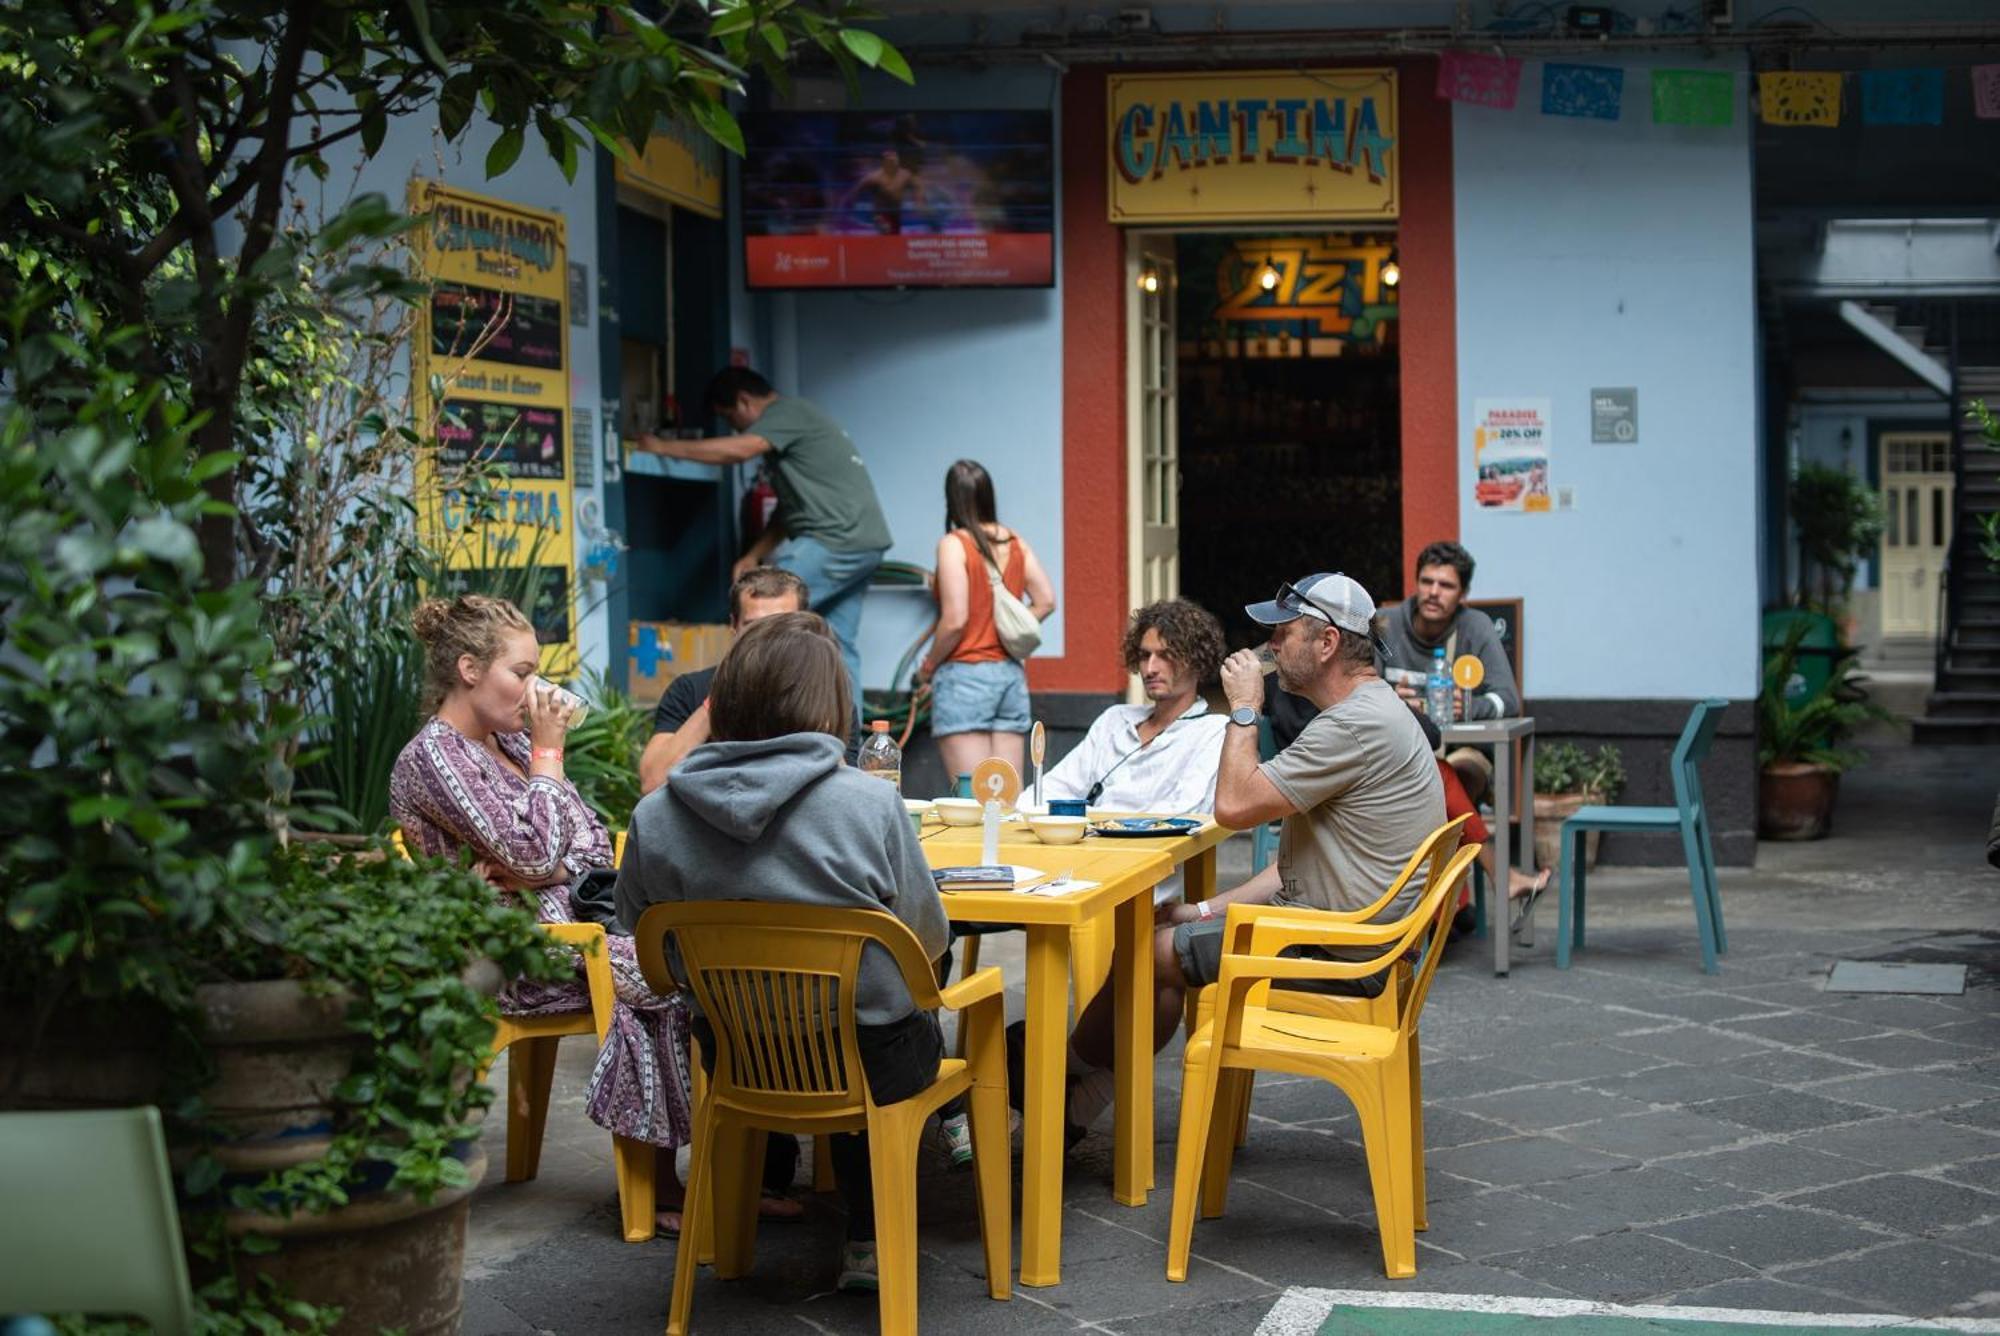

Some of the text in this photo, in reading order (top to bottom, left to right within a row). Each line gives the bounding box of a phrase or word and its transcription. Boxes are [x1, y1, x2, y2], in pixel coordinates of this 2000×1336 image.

[1114, 97, 1395, 184] CANTINA
[1488, 410, 1537, 418] PARADISE
[1500, 428, 1521, 438] 20%
[1523, 428, 1542, 438] OFF
[987, 773, 1004, 797] 9
